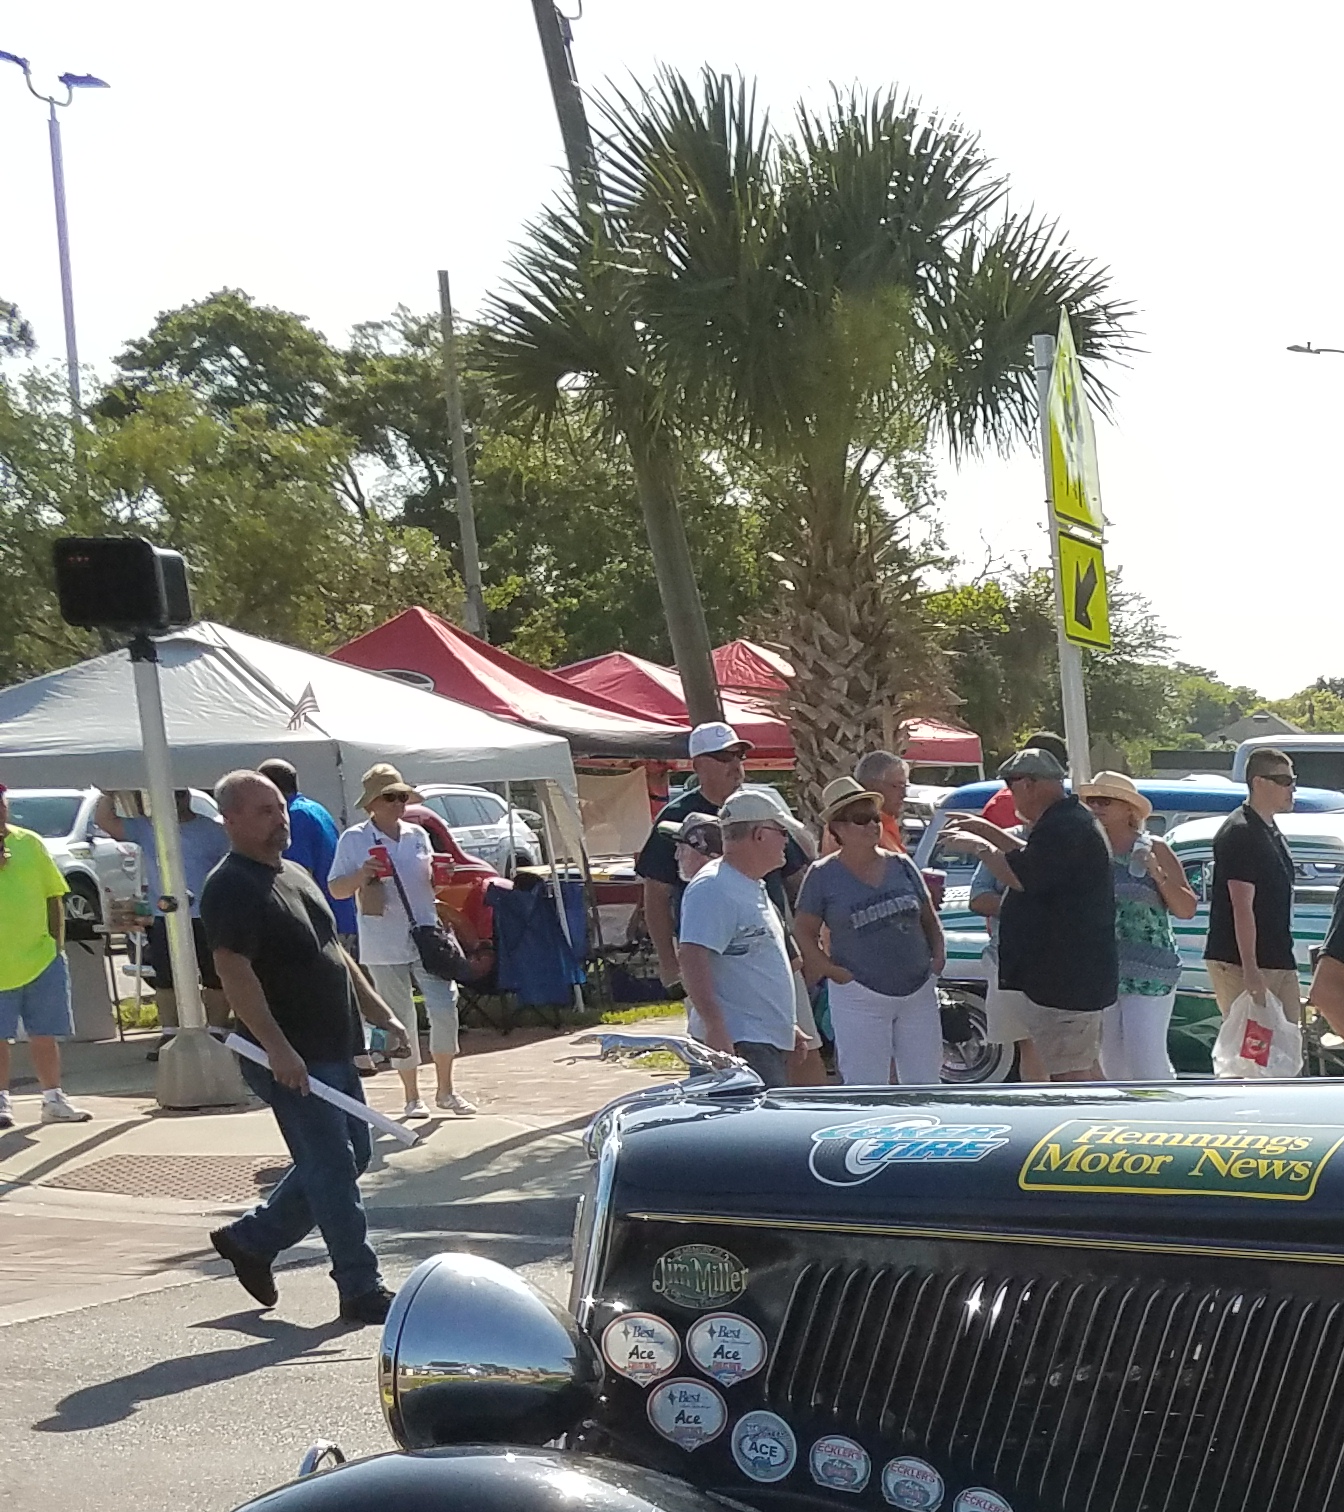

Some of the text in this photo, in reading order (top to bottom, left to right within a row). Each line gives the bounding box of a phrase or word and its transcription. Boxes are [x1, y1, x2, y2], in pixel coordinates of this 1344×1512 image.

[1073, 1125, 1314, 1156] Hemmings
[864, 1140, 997, 1159] TIRE
[1033, 1143, 1314, 1182] Motor News
[652, 1256, 692, 1293] Jim
[689, 1257, 750, 1298] Miller
[632, 1325, 656, 1339] Best
[717, 1325, 742, 1340] Best
[628, 1345, 656, 1360] Ace
[712, 1344, 742, 1361] Ace
[674, 1409, 703, 1425] Ace
[747, 1441, 778, 1458] ACE
